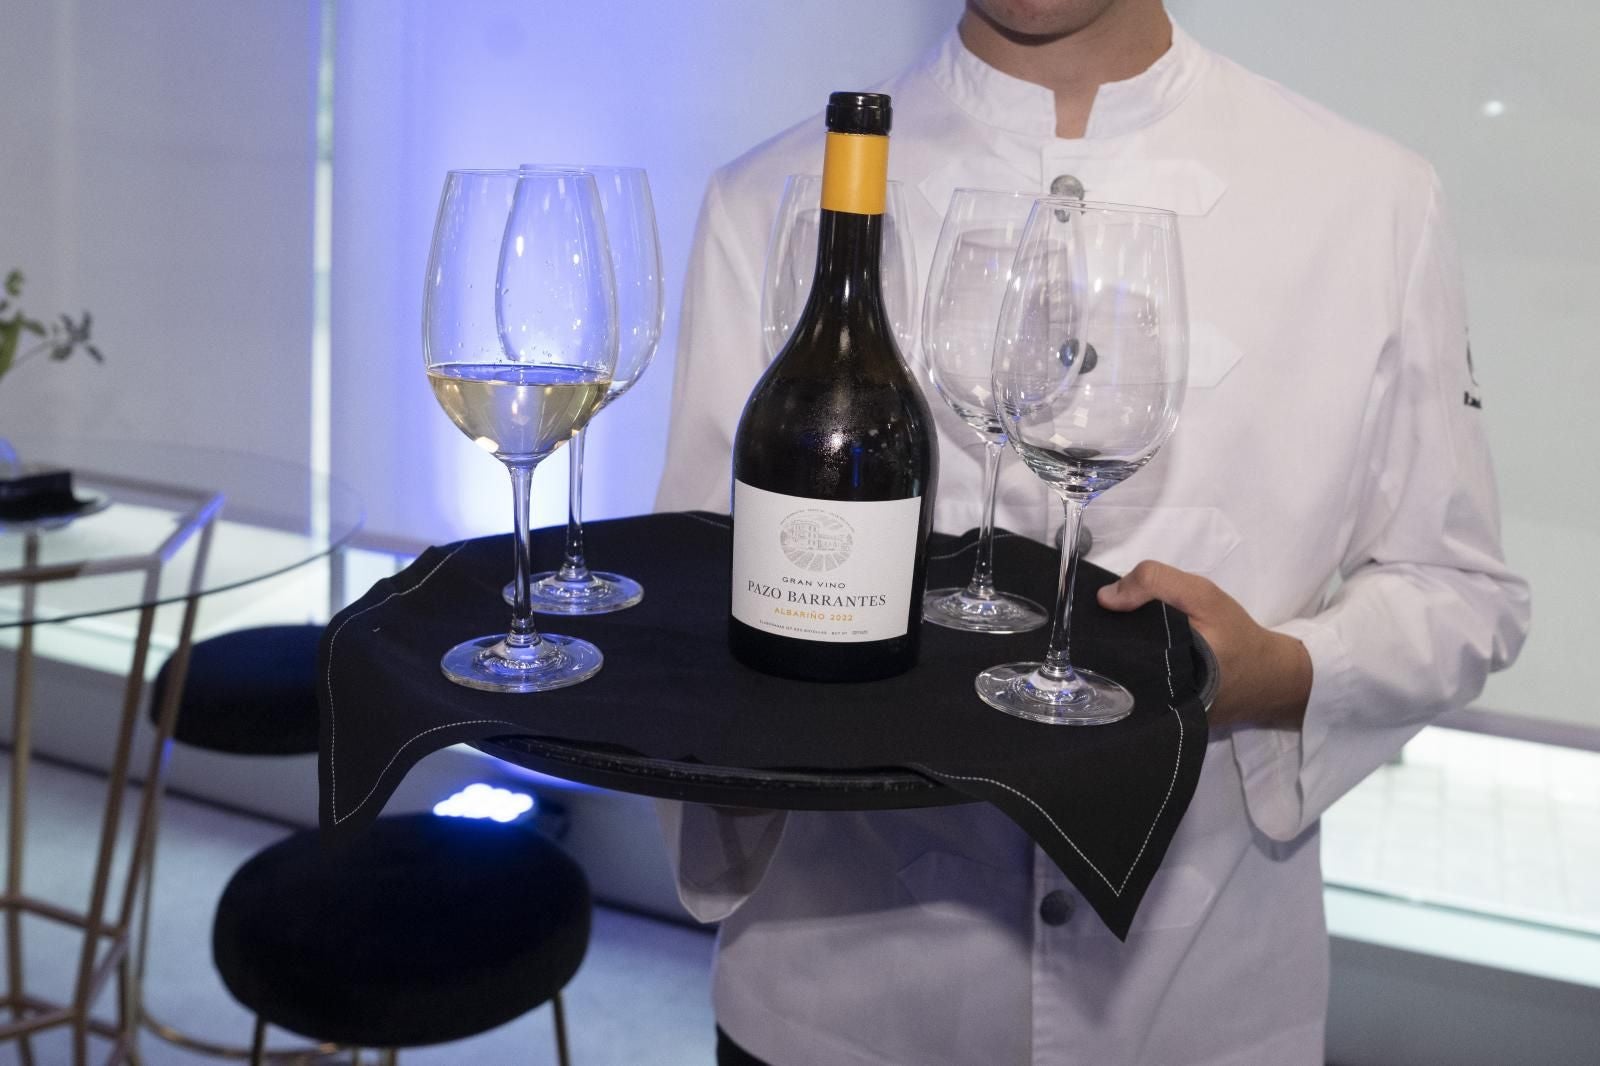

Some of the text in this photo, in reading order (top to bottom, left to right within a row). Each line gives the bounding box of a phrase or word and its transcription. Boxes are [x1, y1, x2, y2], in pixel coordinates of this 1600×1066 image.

[782, 576, 846, 589] GRAN VINO
[748, 580, 887, 608] PAZO BARRANTES
[774, 606, 854, 622] ALBARIÑO 2022
